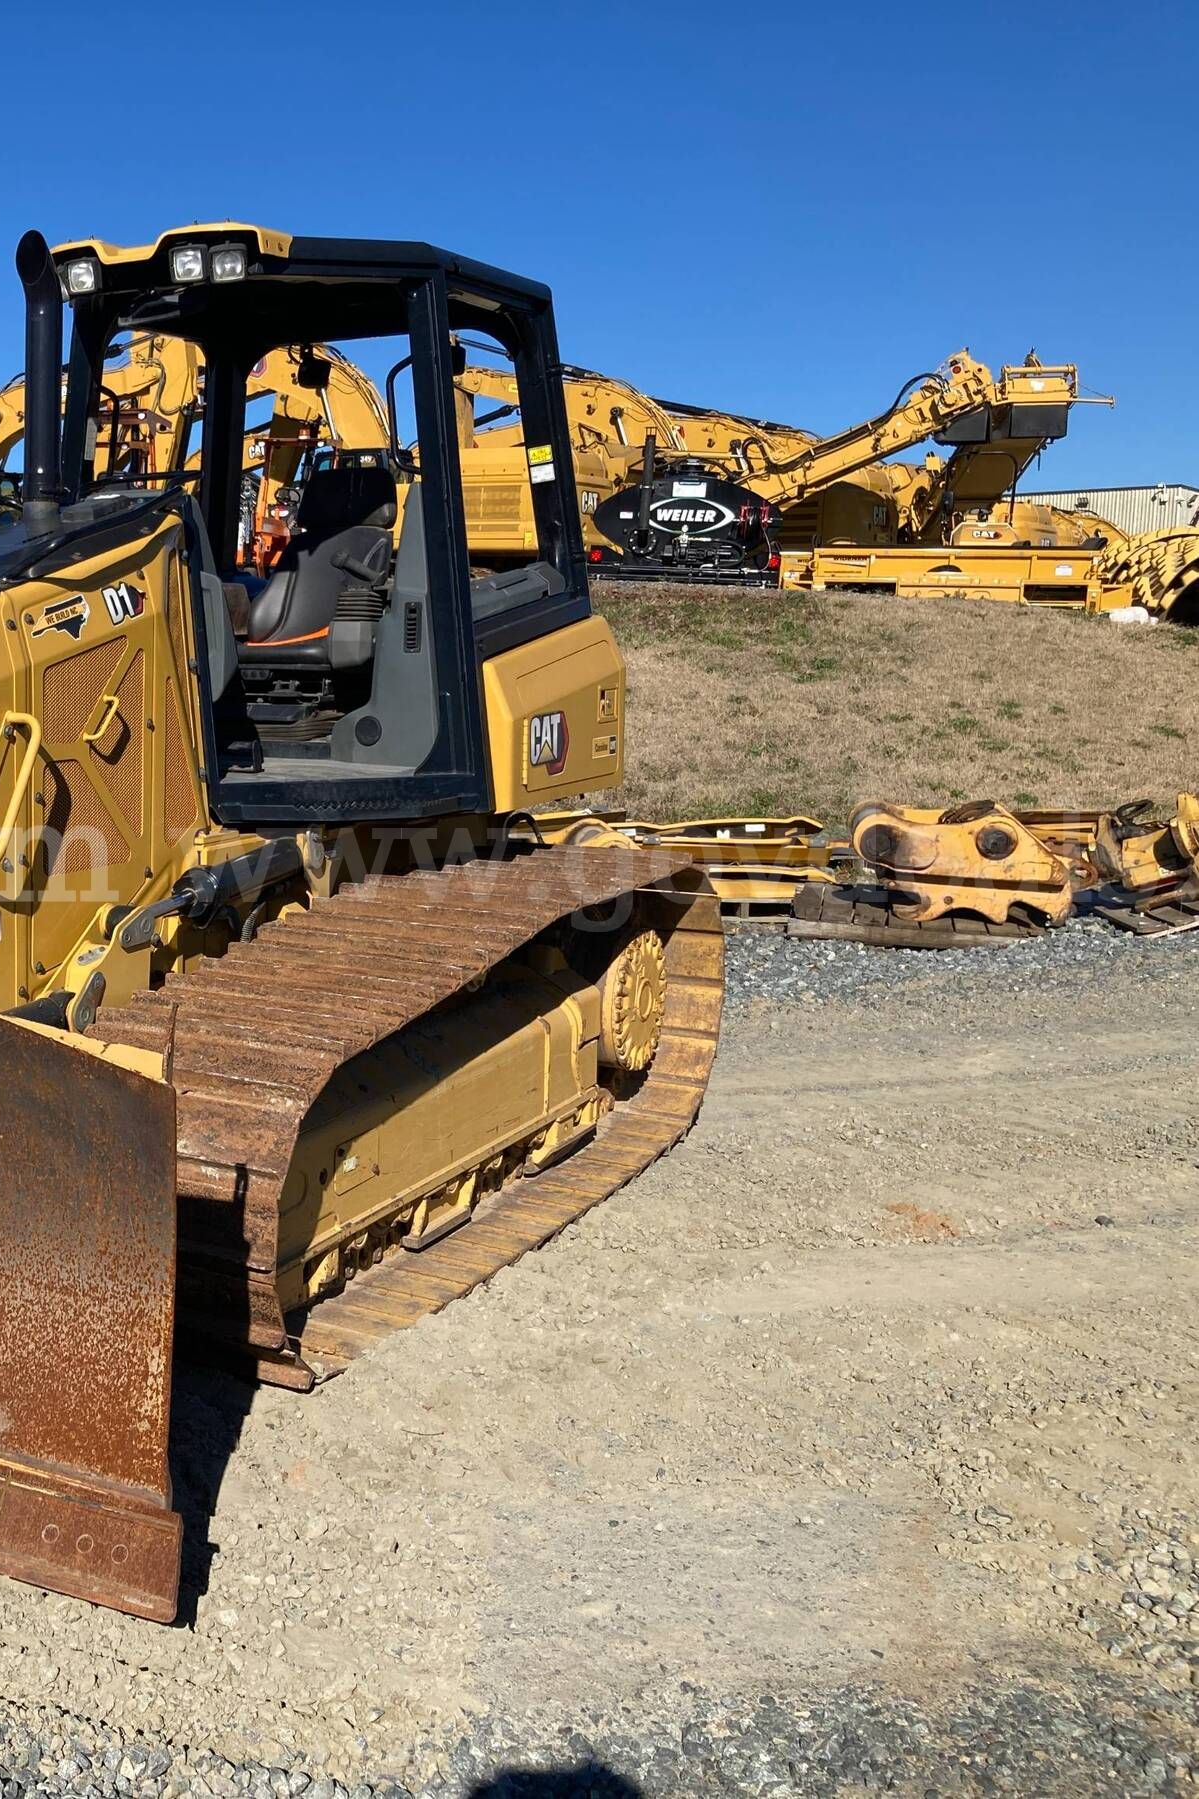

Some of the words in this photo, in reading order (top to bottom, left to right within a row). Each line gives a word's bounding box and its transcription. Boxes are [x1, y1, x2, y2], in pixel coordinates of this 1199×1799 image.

[581, 491, 598, 513] CAT
[656, 508, 717, 523] WEILER
[873, 506, 888, 526] CAT
[972, 530, 996, 539] CAT
[102, 583, 135, 624] D1
[45, 614, 56, 625] WE
[55, 608, 71, 621] BUILD
[70, 606, 79, 617] NC
[530, 713, 561, 766] CAT
